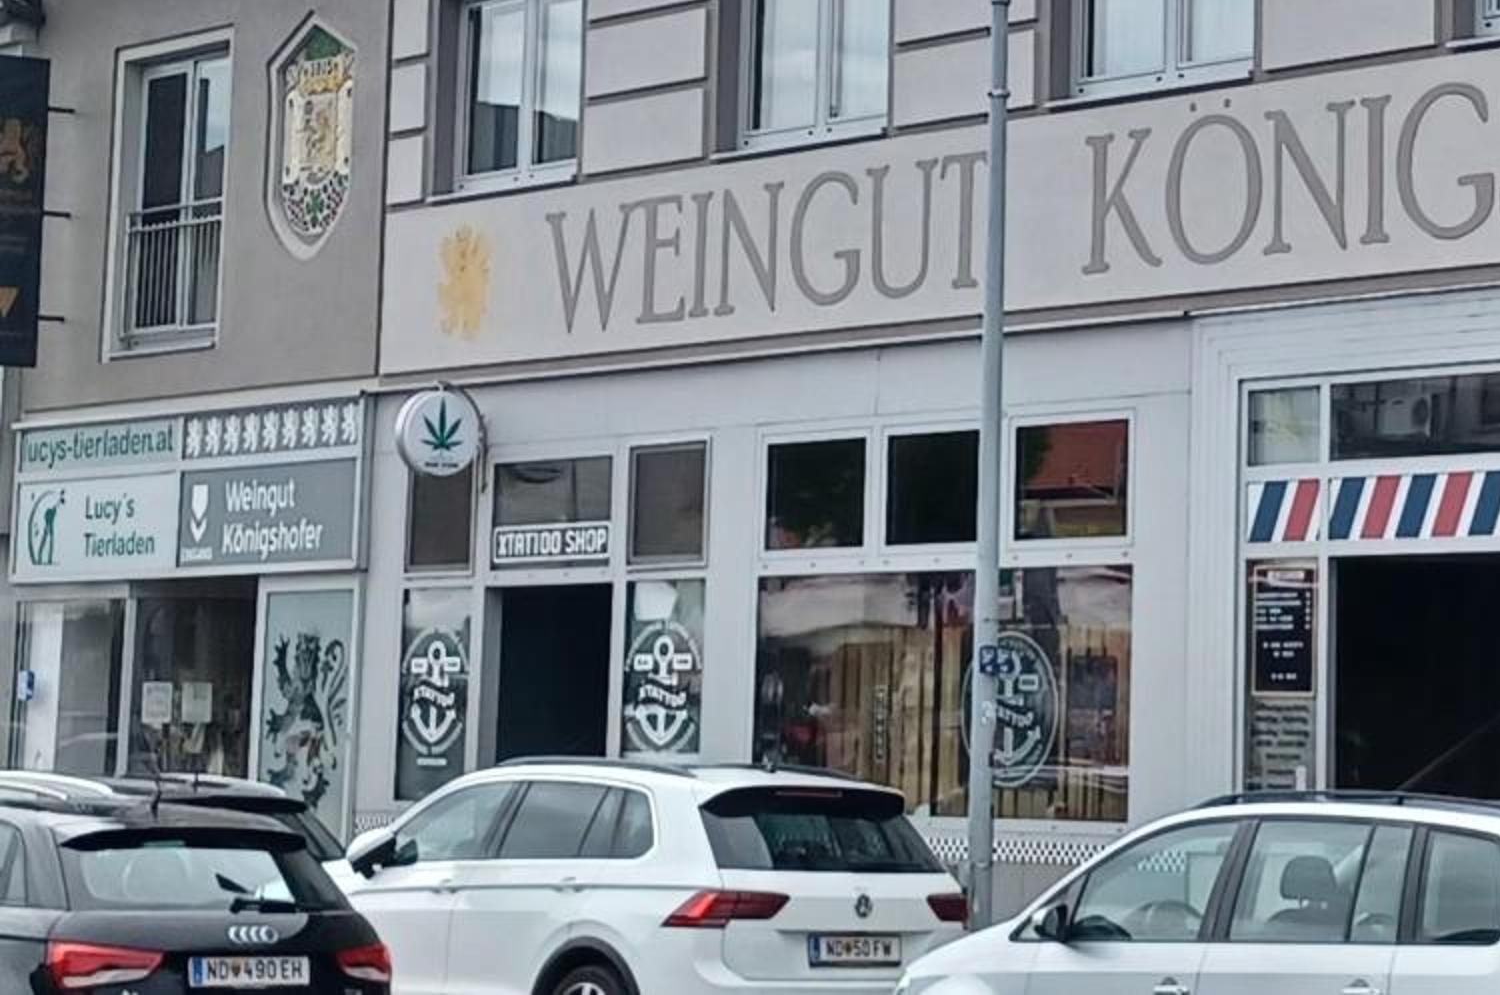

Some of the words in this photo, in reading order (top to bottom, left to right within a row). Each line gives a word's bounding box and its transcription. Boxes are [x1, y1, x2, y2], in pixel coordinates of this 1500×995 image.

[546, 150, 988, 334] WEINGUT
[225, 479, 296, 518] Weingut
[84, 533, 155, 558] Tierladen
[222, 520, 324, 561] Königshofer
[564, 527, 608, 553] SHOP
[205, 958, 230, 980] ND
[245, 958, 278, 979] 490
[282, 957, 303, 979] EH
